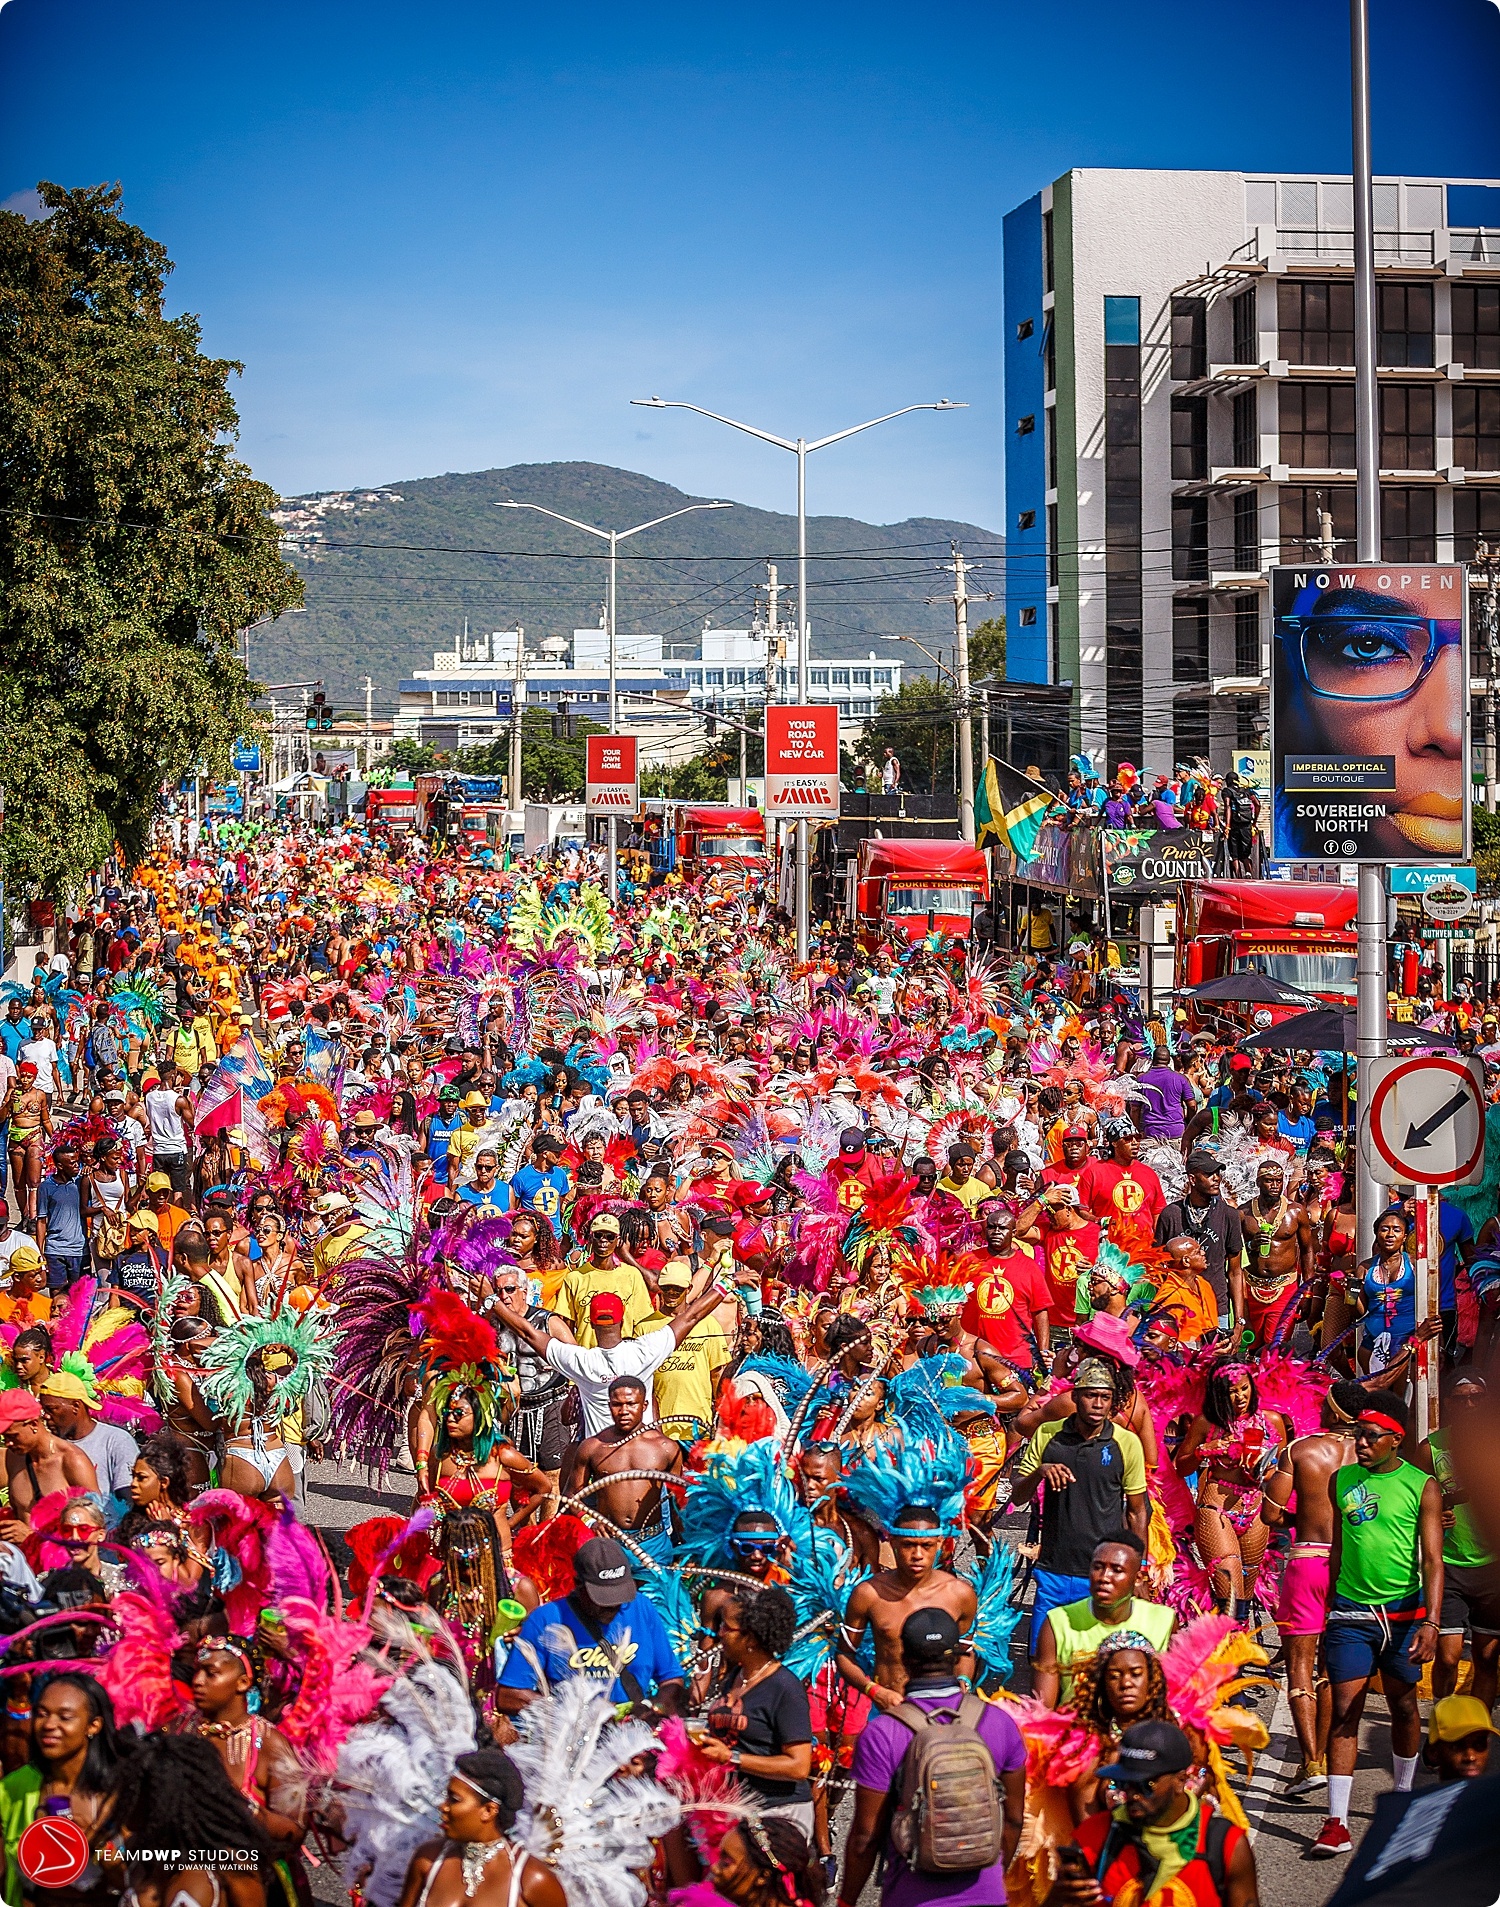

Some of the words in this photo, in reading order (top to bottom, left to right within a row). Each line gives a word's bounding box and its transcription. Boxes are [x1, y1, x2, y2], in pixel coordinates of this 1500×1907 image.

[1294, 574, 1356, 588] NOW
[1377, 574, 1454, 590] OPEN
[788, 720, 816, 729] YOUR
[788, 730, 816, 739] ROAD
[790, 740, 803, 748] TO
[804, 740, 813, 748] A
[780, 750, 802, 759] NEW
[804, 750, 824, 759] CAR
[1296, 805, 1386, 817] SOVEREIGN
[1315, 820, 1368, 832] NORTH
[1161, 846, 1196, 860] Pure
[1423, 874, 1456, 882] ACTIVE
[932, 882, 980, 890] TRUCKING
[1423, 930, 1452, 938] RUTHVEN
[1455, 930, 1465, 938] RD.
[1248, 945, 1298, 953] ZOUKIE
[658, 1356, 695, 1372] Babes
[599, 1565, 626, 1580] Chill
